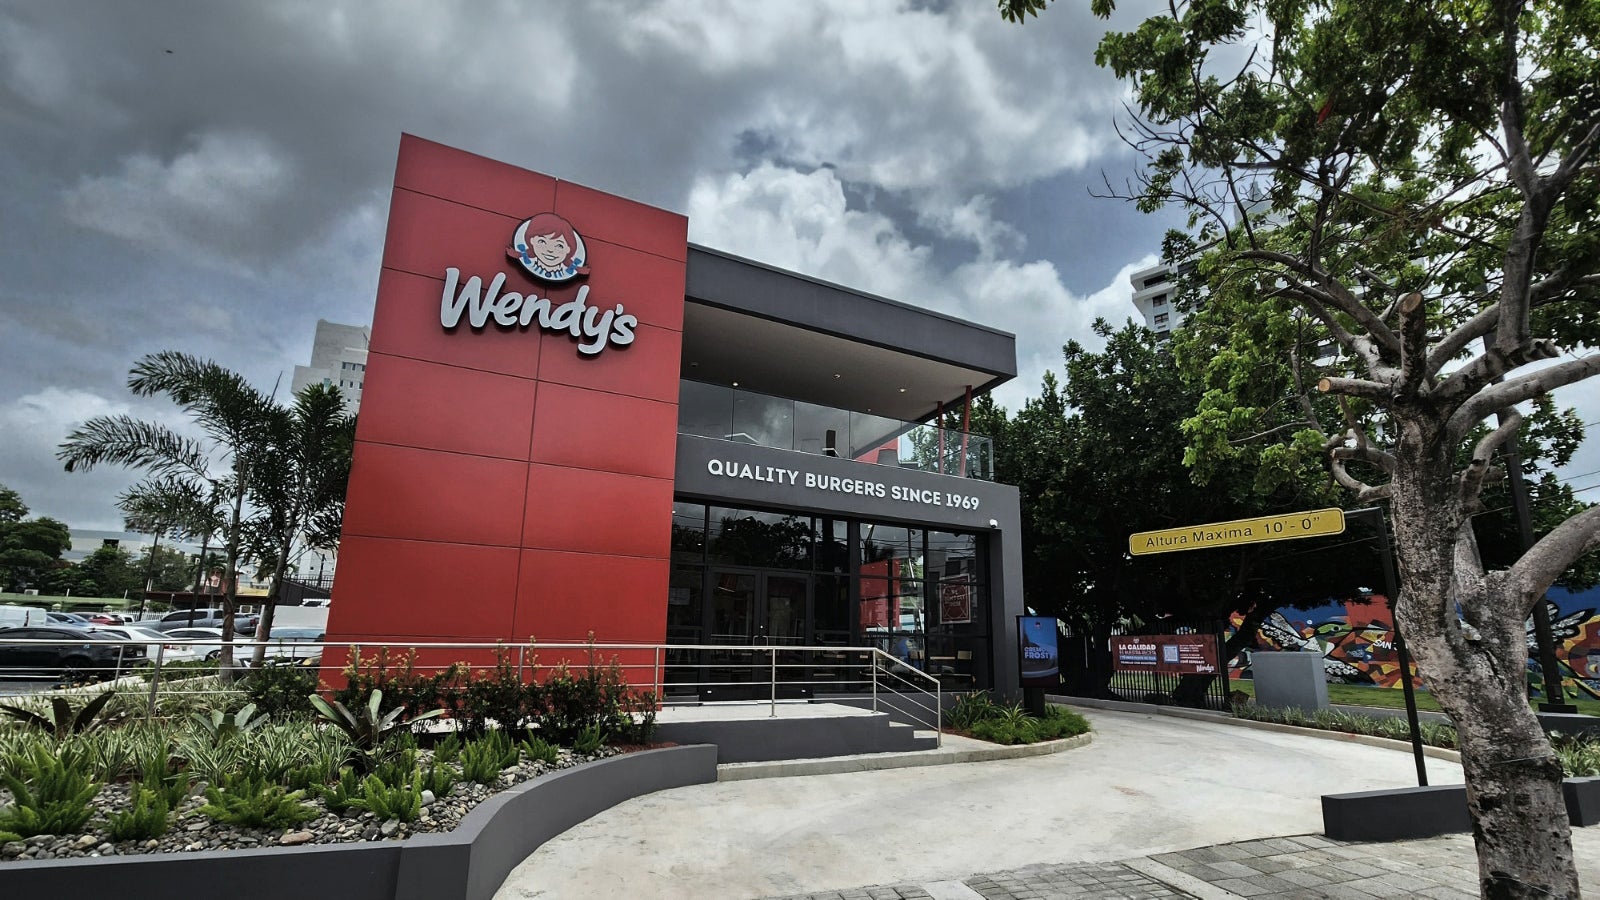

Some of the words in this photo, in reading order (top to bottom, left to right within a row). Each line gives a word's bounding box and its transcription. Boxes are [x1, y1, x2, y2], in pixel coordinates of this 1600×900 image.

[440, 267, 638, 355] Wendy's
[707, 459, 799, 485] QUALITY
[805, 472, 886, 498] BURGERS
[891, 485, 941, 506] SINCE
[946, 493, 979, 510] 1969
[1146, 535, 1188, 548] Altura
[1192, 527, 1253, 542] Maxima
[1373, 639, 1392, 650] SAN
